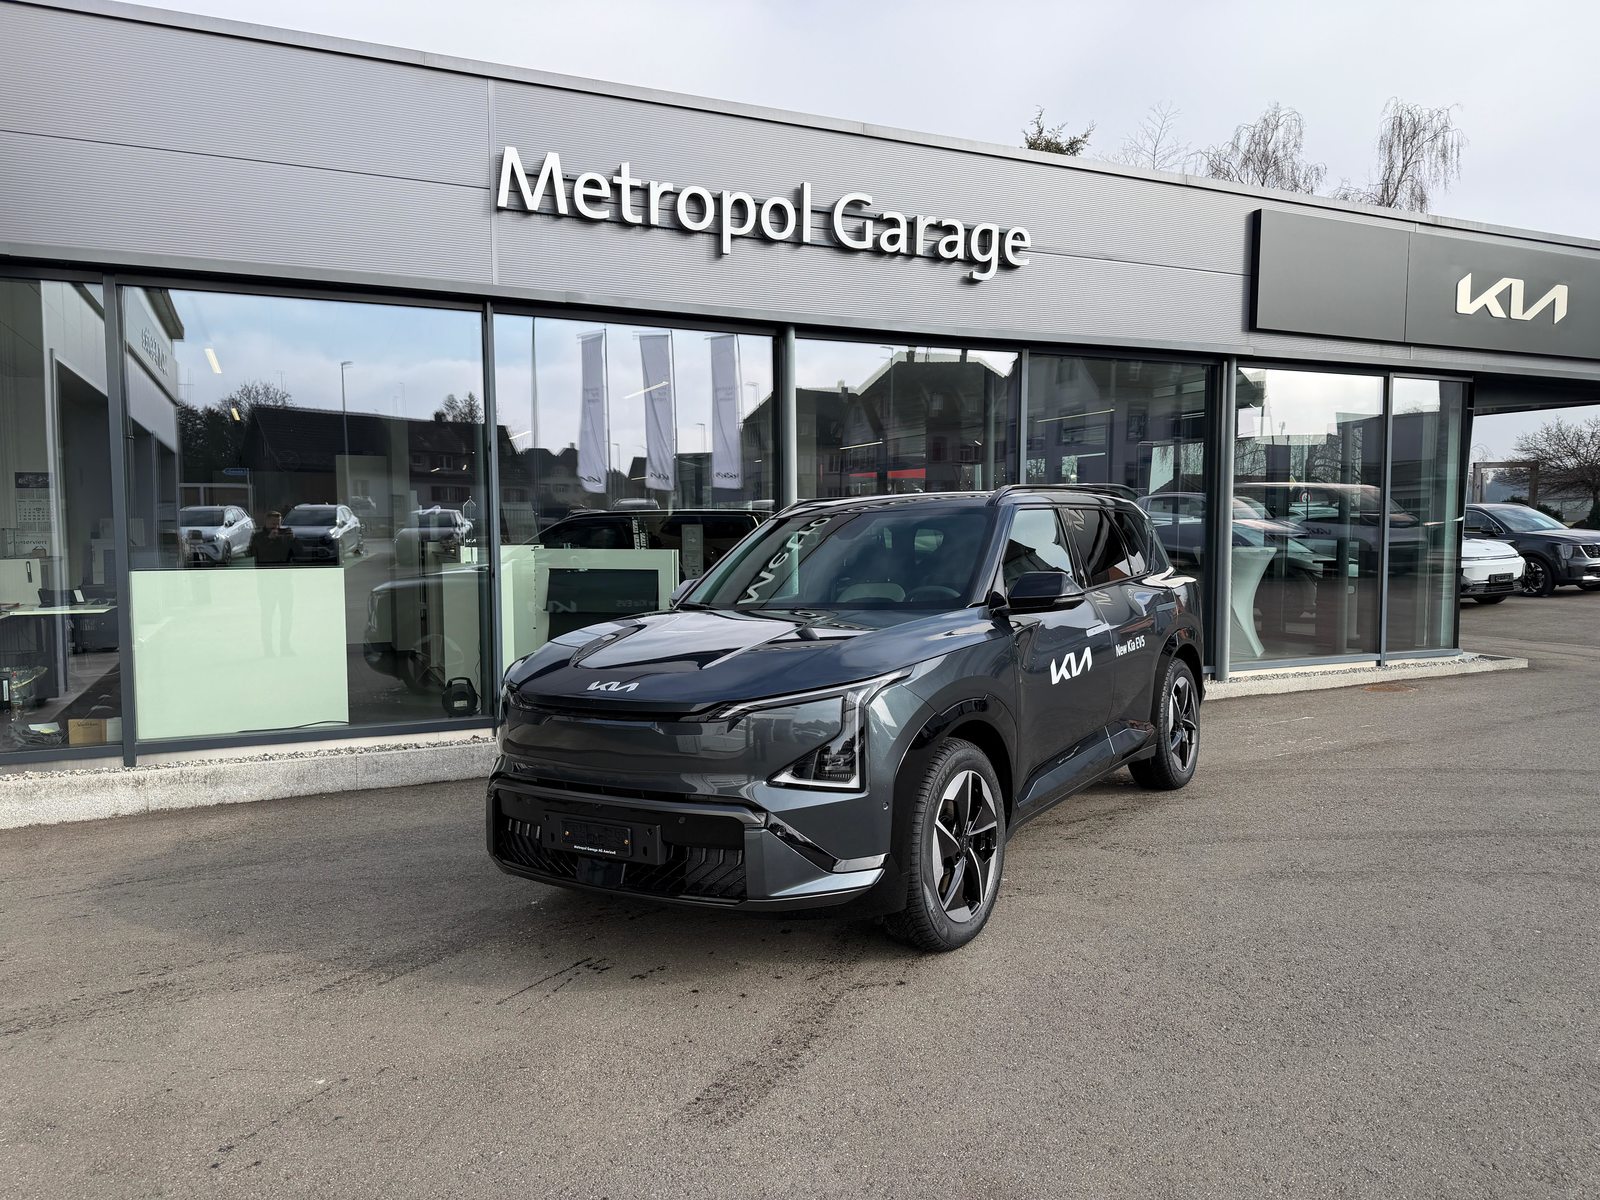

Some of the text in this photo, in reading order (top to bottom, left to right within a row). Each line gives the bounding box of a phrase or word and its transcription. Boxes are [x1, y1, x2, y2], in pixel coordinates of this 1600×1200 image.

[496, 145, 1032, 281] Metropol Garage
[1455, 271, 1569, 325] KIA
[1050, 646, 1093, 685] KIA
[1115, 635, 1146, 658] New Kia EV5
[586, 681, 640, 693] KIA
